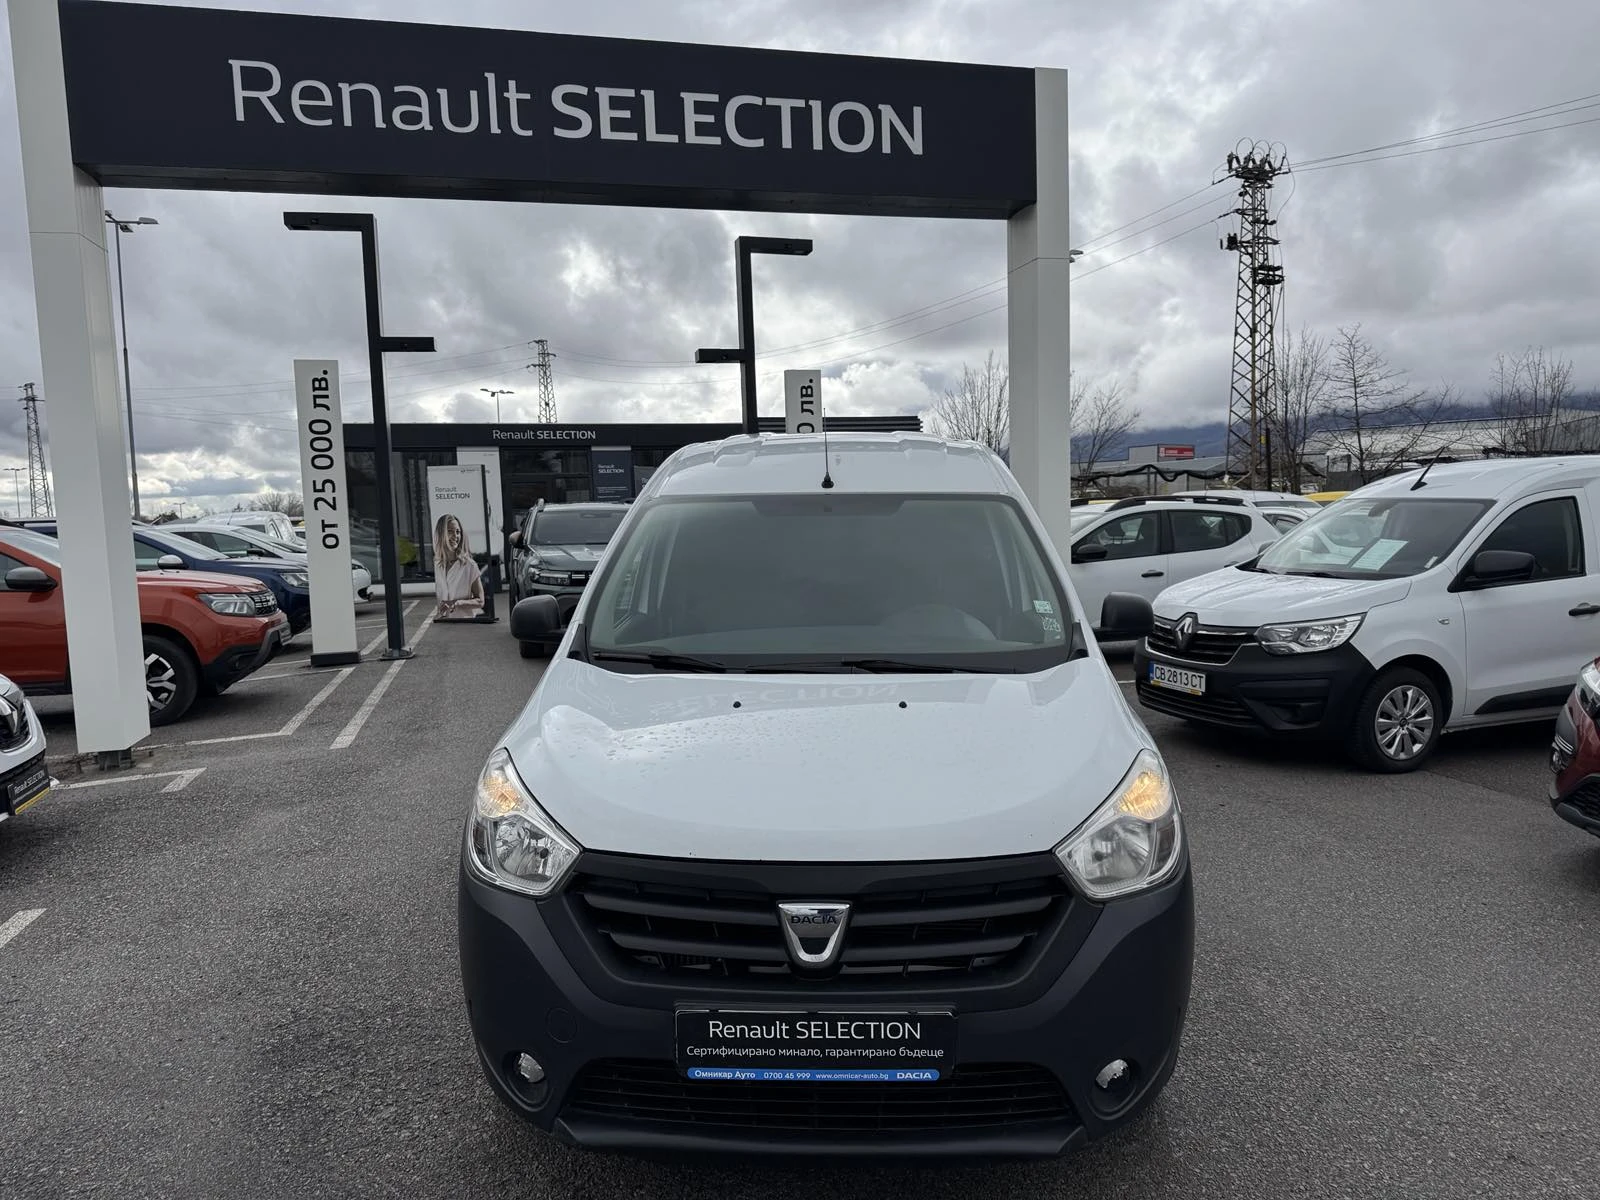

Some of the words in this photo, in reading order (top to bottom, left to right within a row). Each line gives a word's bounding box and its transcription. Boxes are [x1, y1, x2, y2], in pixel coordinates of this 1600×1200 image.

[228, 58, 533, 136] Renault
[551, 84, 924, 155] SELECTION
[311, 369, 331, 411] лв.
[800, 378, 814, 415] лв.
[308, 418, 334, 470] 000
[492, 429, 535, 440] Renault
[536, 430, 596, 440] SELECTION
[312, 478, 337, 511] 25
[435, 492, 471, 500] SELECTION
[321, 519, 340, 549] от
[790, 915, 837, 925] DACIA
[708, 1020, 790, 1039] Renault
[796, 1021, 921, 1040] SELECTION
[686, 1045, 776, 1058] Сертифицирано
[778, 1048, 823, 1058] минало,
[825, 1047, 897, 1059] гарантирано
[898, 1046, 944, 1058] бъдеще
[694, 1070, 733, 1079] Омникар
[734, 1071, 756, 1079] Ауто
[763, 1072, 783, 1080] 0700
[784, 1072, 795, 1080] 45
[796, 1072, 811, 1080] 999
[815, 1072, 889, 1081] www.omnicar-auto.bg
[896, 1072, 932, 1080] DACIA
